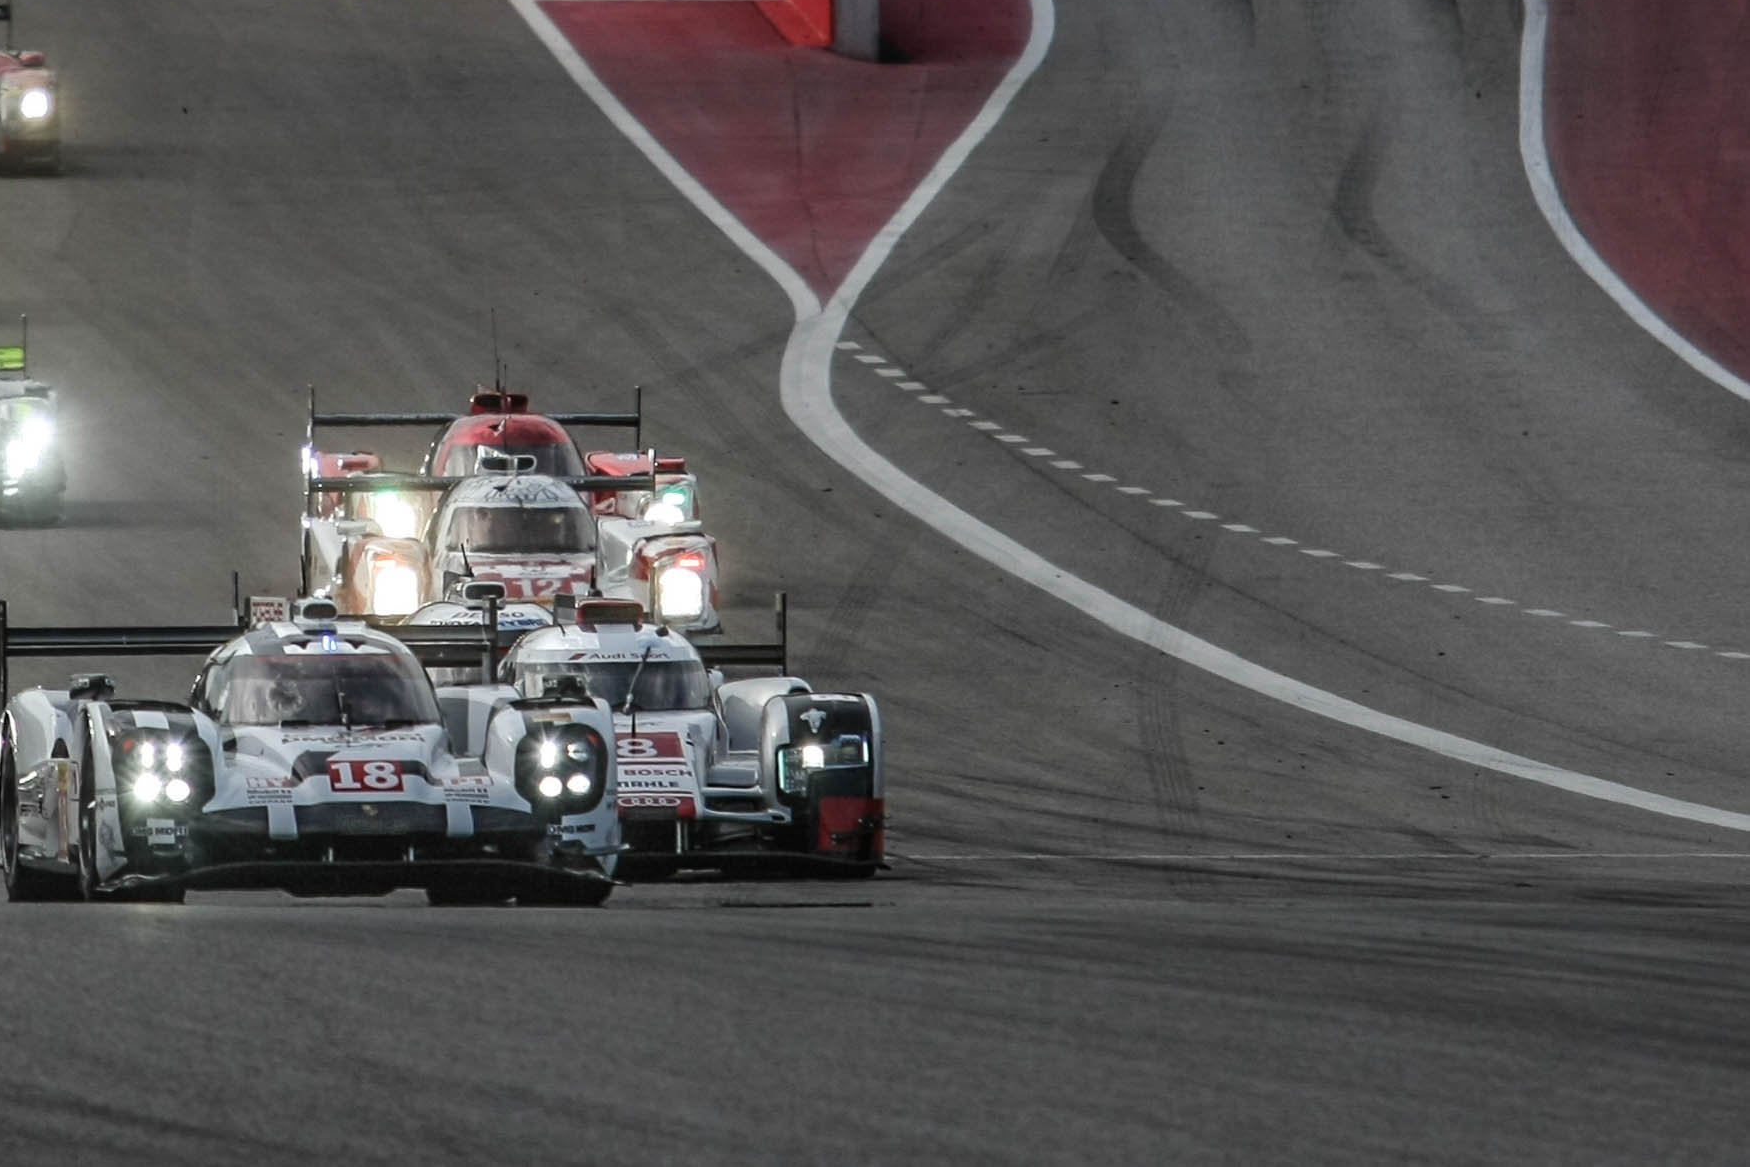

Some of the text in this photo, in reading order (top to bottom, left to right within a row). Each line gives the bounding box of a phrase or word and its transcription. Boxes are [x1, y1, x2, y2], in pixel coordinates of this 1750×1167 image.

[617, 738, 658, 758] 8
[330, 761, 399, 789] 18
[623, 769, 693, 777] BOSCH
